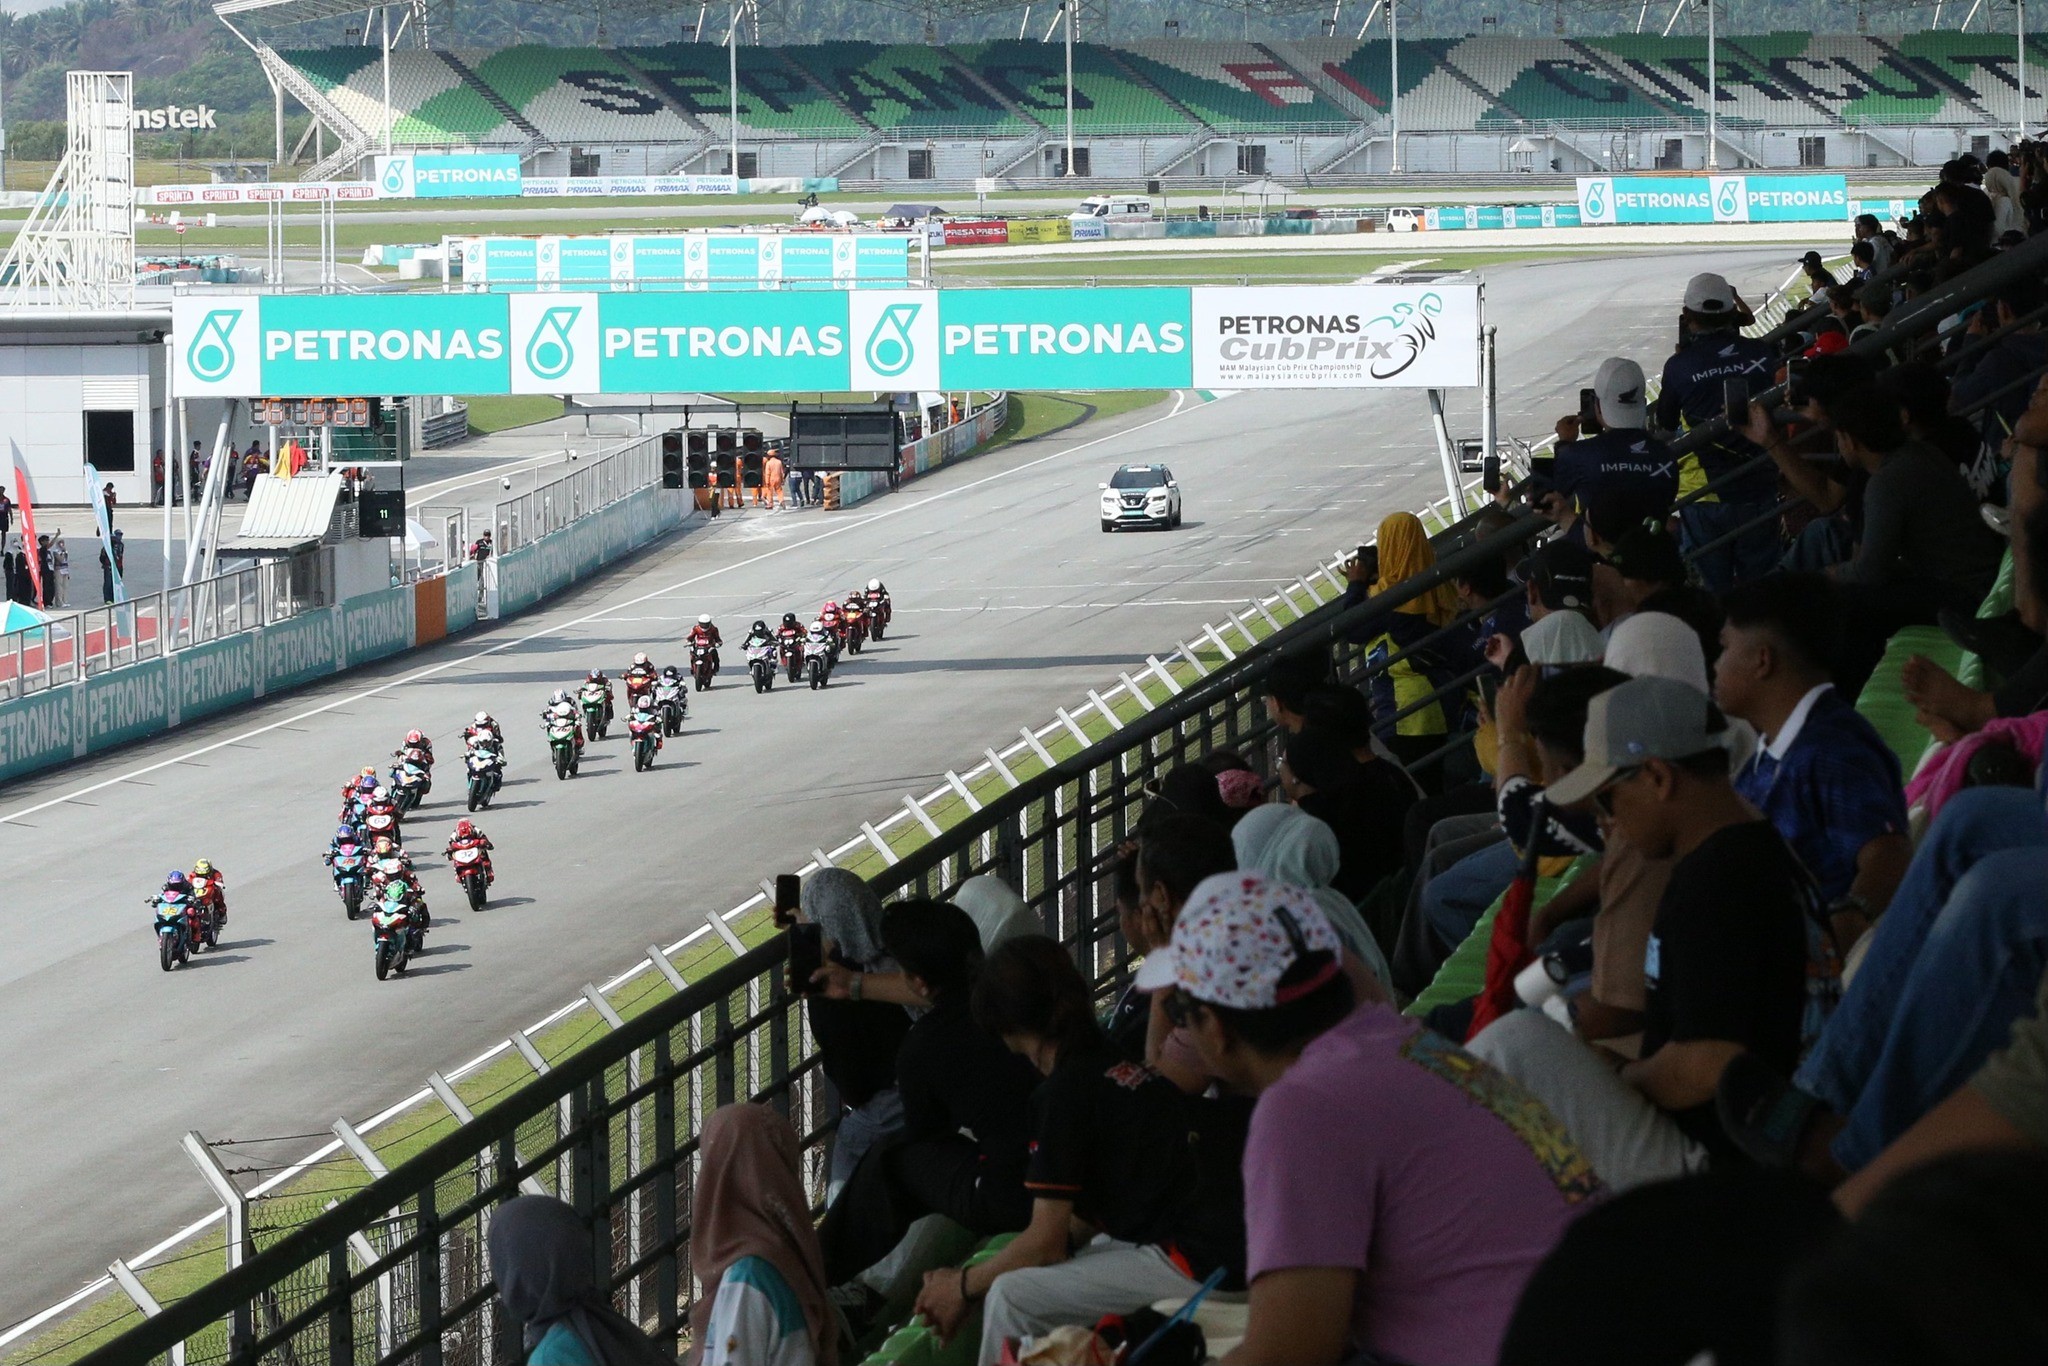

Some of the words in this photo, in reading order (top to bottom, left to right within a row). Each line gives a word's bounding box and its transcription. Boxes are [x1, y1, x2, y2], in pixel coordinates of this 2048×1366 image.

[558, 66, 1094, 114] SEPANG
[1535, 55, 2041, 102] CIRCUIT
[133, 105, 216, 129] nstek
[416, 168, 518, 183] PETRONAS
[294, 188, 328, 199] SPRINTA
[339, 187, 373, 198] SPRINTA
[522, 186, 558, 194] PRIMAX
[696, 184, 732, 192] PRIMAX
[158, 191, 193, 201] SPRINTA
[204, 190, 238, 200] SPRINTA
[249, 189, 283, 199] SPRINTA
[1616, 193, 1710, 208] PETRONAS
[1749, 190, 1844, 206] PETRONAS
[562, 249, 607, 257] PETRONAS
[636, 248, 681, 256] PETRONAS
[859, 248, 904, 256] PETRONAS
[1219, 315, 1360, 334] PETRONAS
[265, 328, 503, 361] PETRONAS
[604, 325, 843, 358] PETRONAS
[945, 322, 1185, 355] PETRONAS
[1220, 336, 1394, 361] CubPrix
[1239, 364, 1275, 373] Malaysian
[1310, 363, 1362, 372] Championship
[1220, 372, 1362, 380] www.malaysiancubprix.com
[380, 509, 388, 519] 11
[0, 697, 70, 766] ETRONAS
[90, 670, 164, 737] PETRONAS
[182, 643, 250, 704] PETRONAS
[267, 619, 332, 678] PETRONAS
[346, 600, 404, 652] PETRONAS
